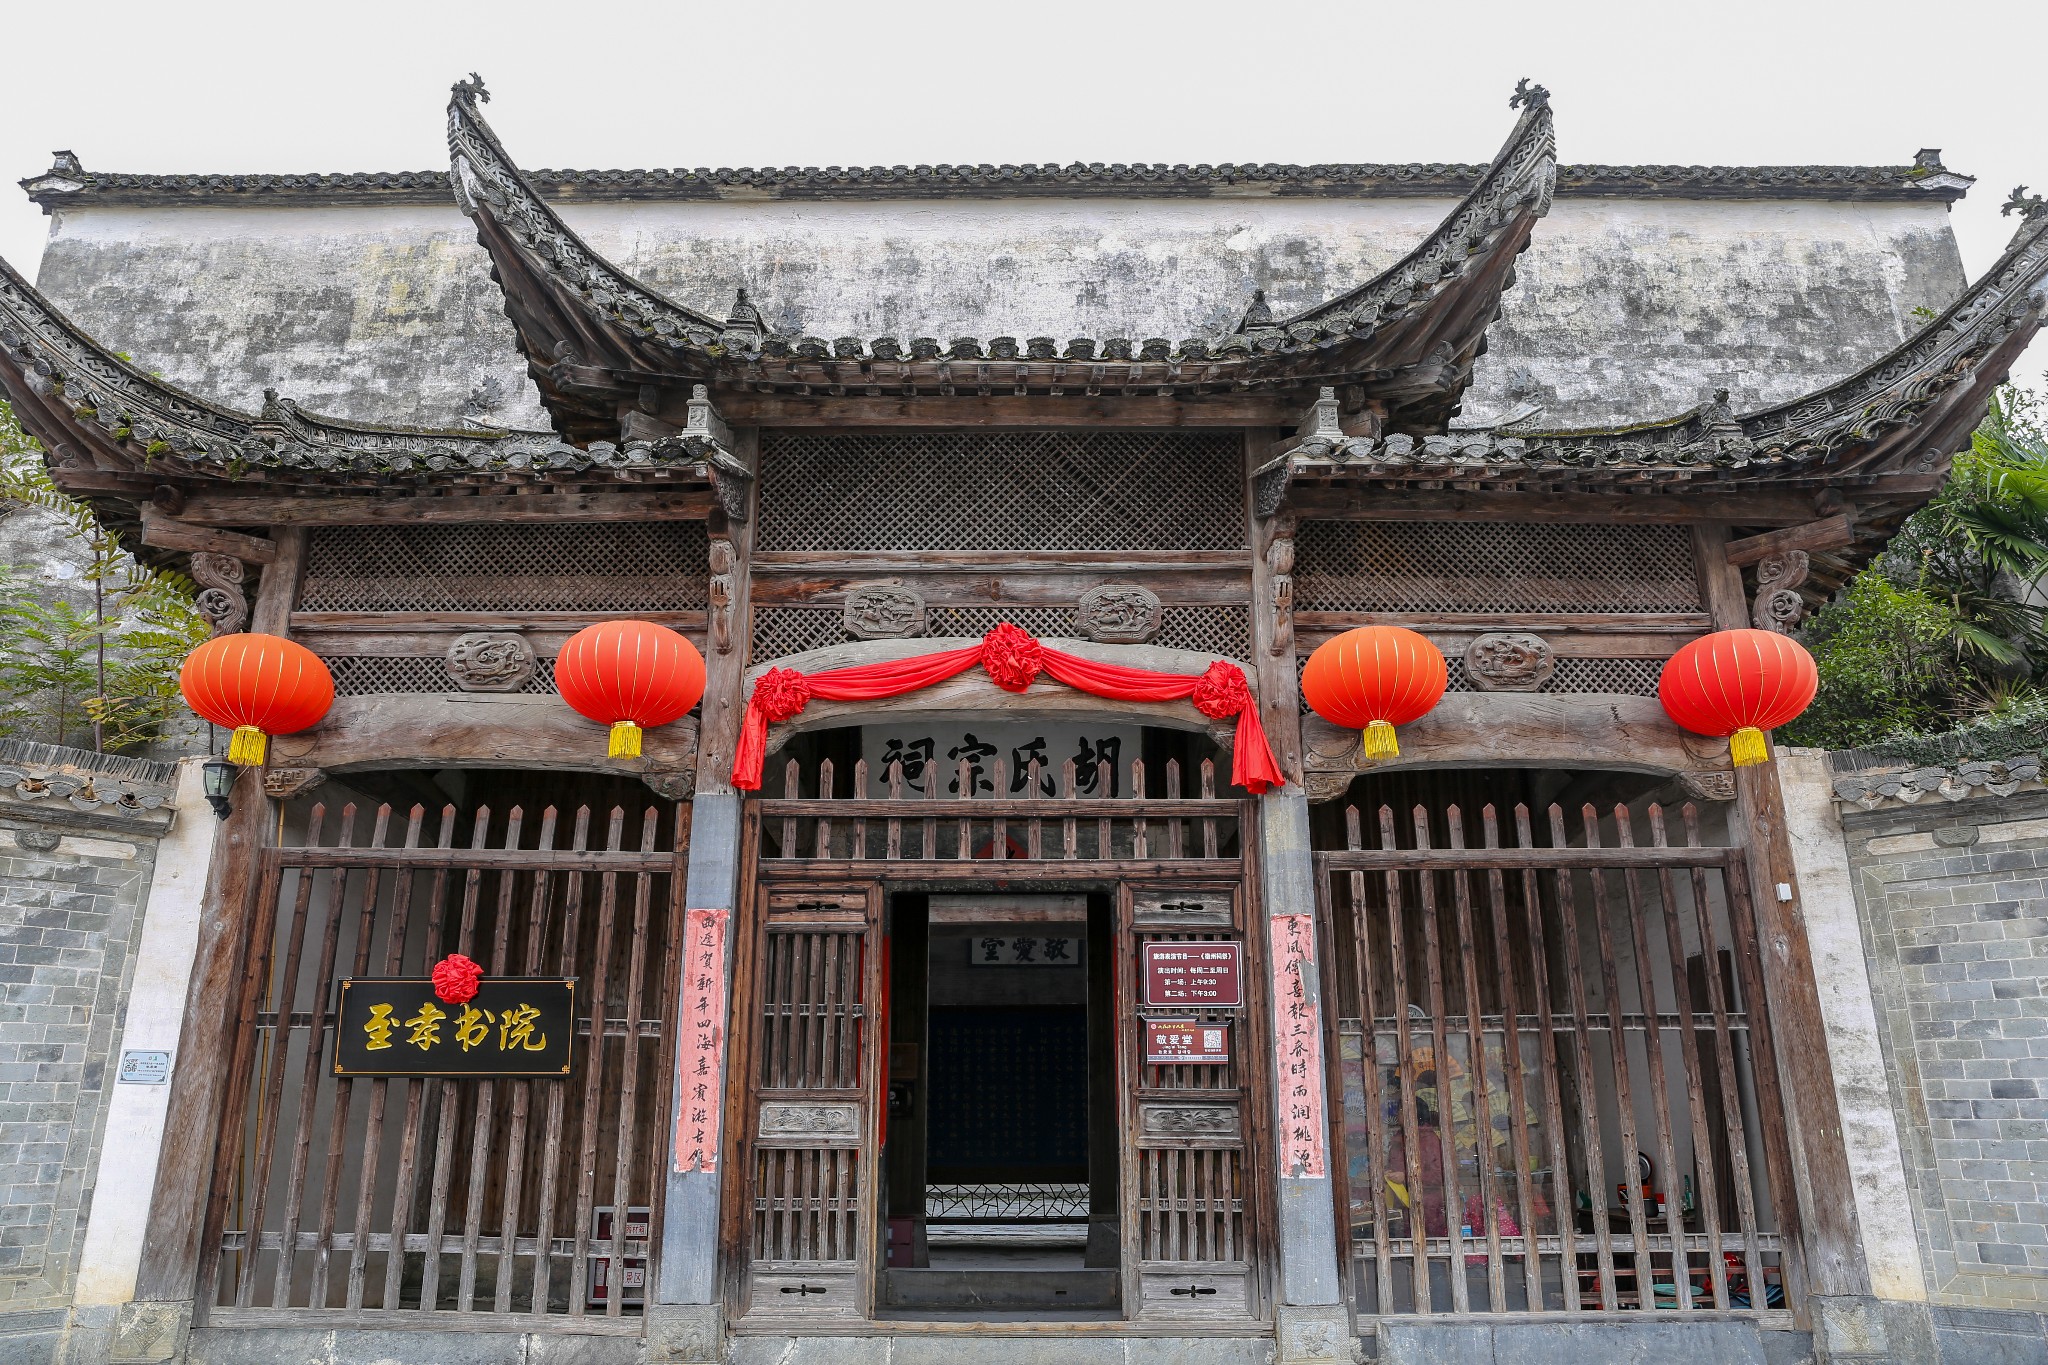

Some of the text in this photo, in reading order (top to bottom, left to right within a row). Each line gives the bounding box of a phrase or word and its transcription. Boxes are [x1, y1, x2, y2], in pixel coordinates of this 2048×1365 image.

[879, 733, 1121, 798] 胡氏宗祠
[1156, 1034, 1193, 1045] 敬爱堂
